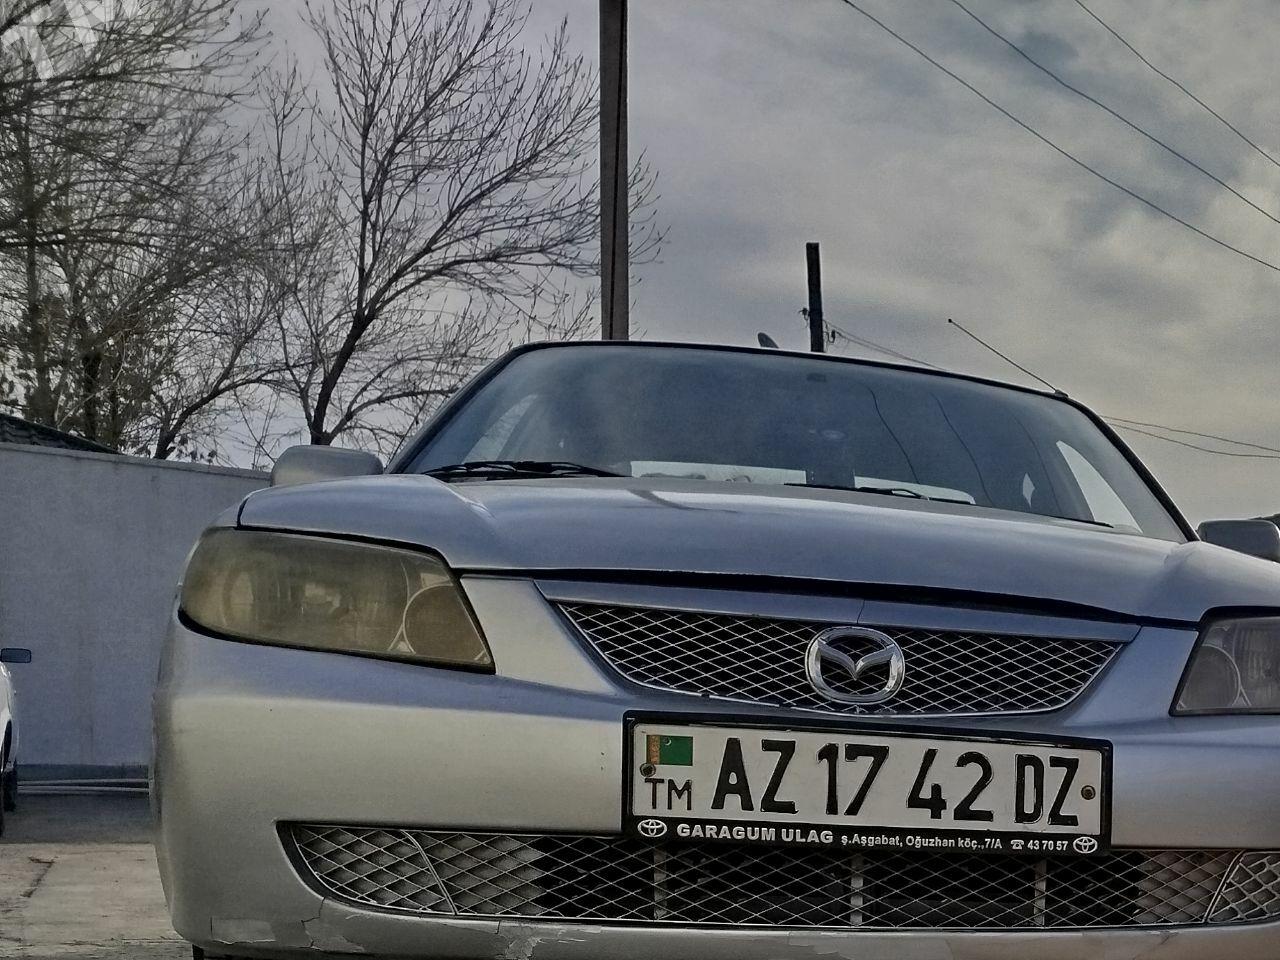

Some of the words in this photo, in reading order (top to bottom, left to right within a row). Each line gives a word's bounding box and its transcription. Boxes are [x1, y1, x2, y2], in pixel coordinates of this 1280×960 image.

[644, 777, 693, 811] TM
[710, 737, 799, 815] AZ
[816, 743, 890, 816] 17
[906, 748, 994, 822] 42
[1014, 753, 1079, 827] DZ
[676, 823, 777, 842] GARAGUM
[781, 828, 834, 844] ULAG
[1027, 839, 1041, 851] 43
[1041, 840, 1055, 851] 70
[1056, 840, 1069, 851] 57
